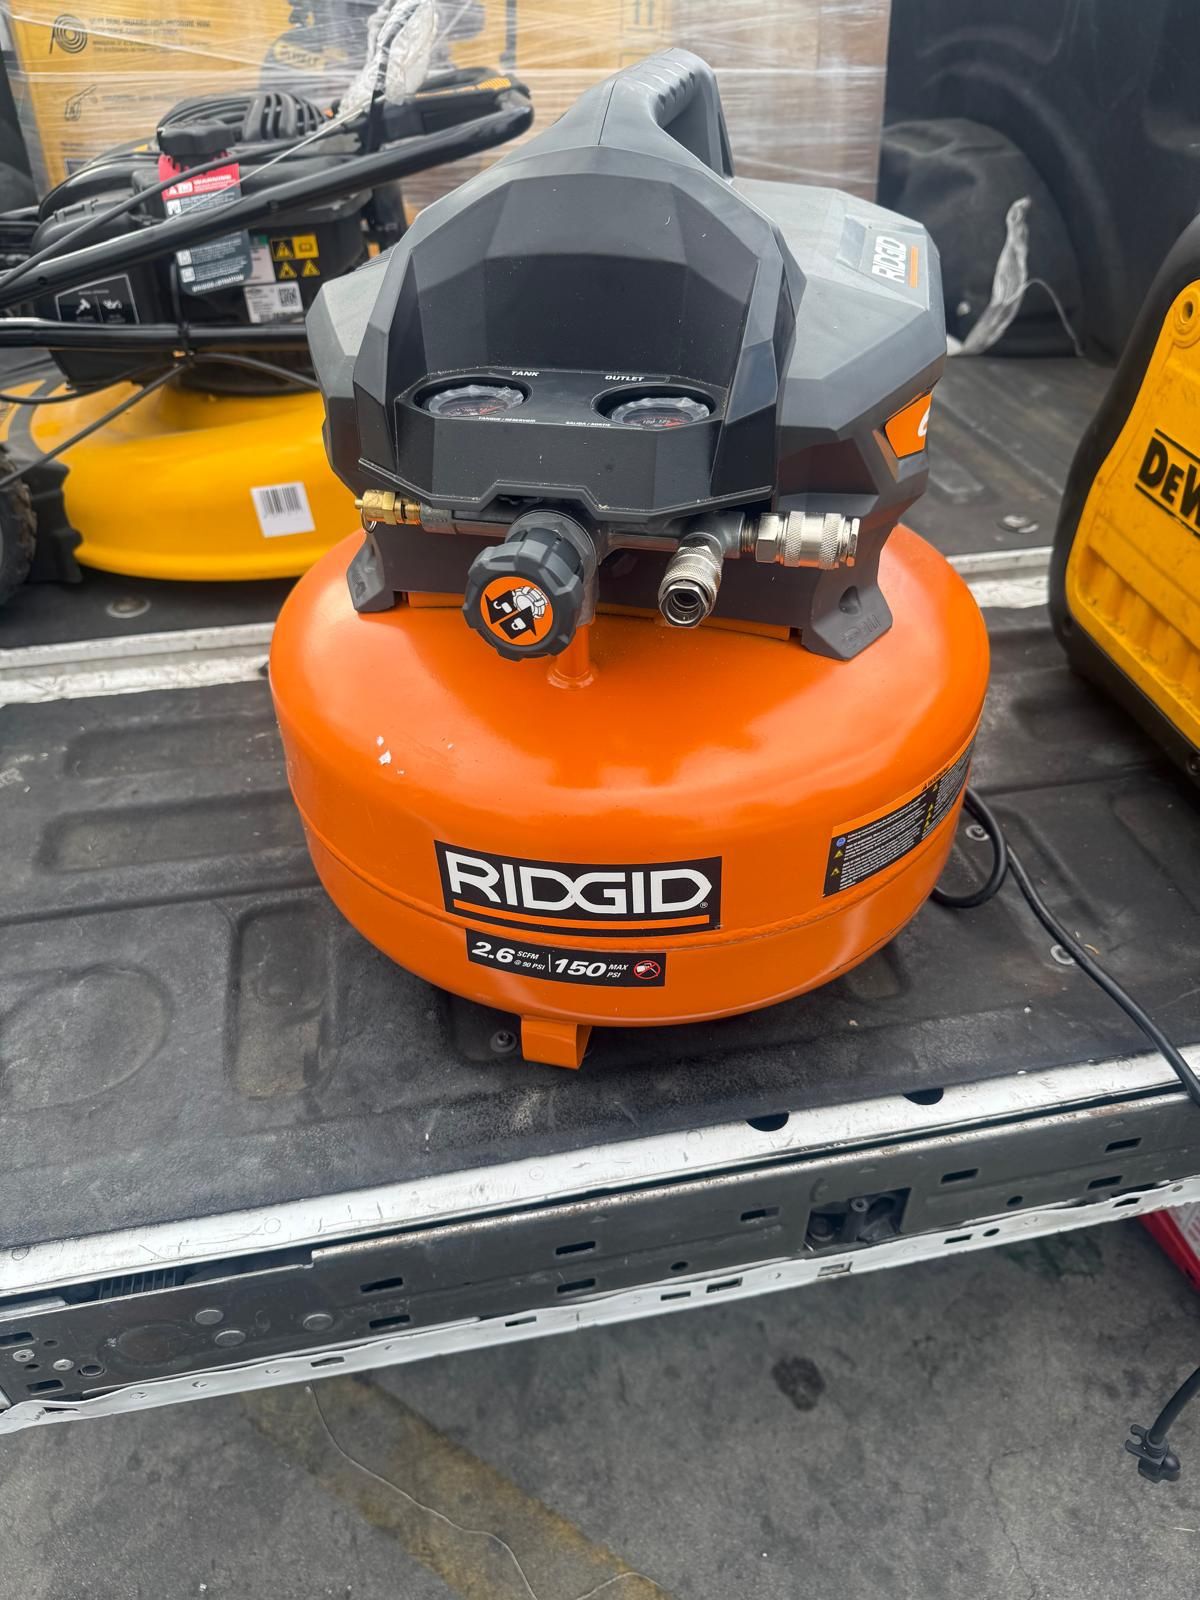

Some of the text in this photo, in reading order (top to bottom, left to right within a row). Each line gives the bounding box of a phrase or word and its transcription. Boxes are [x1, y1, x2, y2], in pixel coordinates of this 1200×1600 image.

[872, 236, 906, 284] RIDGID
[471, 941, 539, 964] 2.6 SCFM
[532, 963, 546, 971] PSI
[554, 958, 629, 977] 150 MAX
